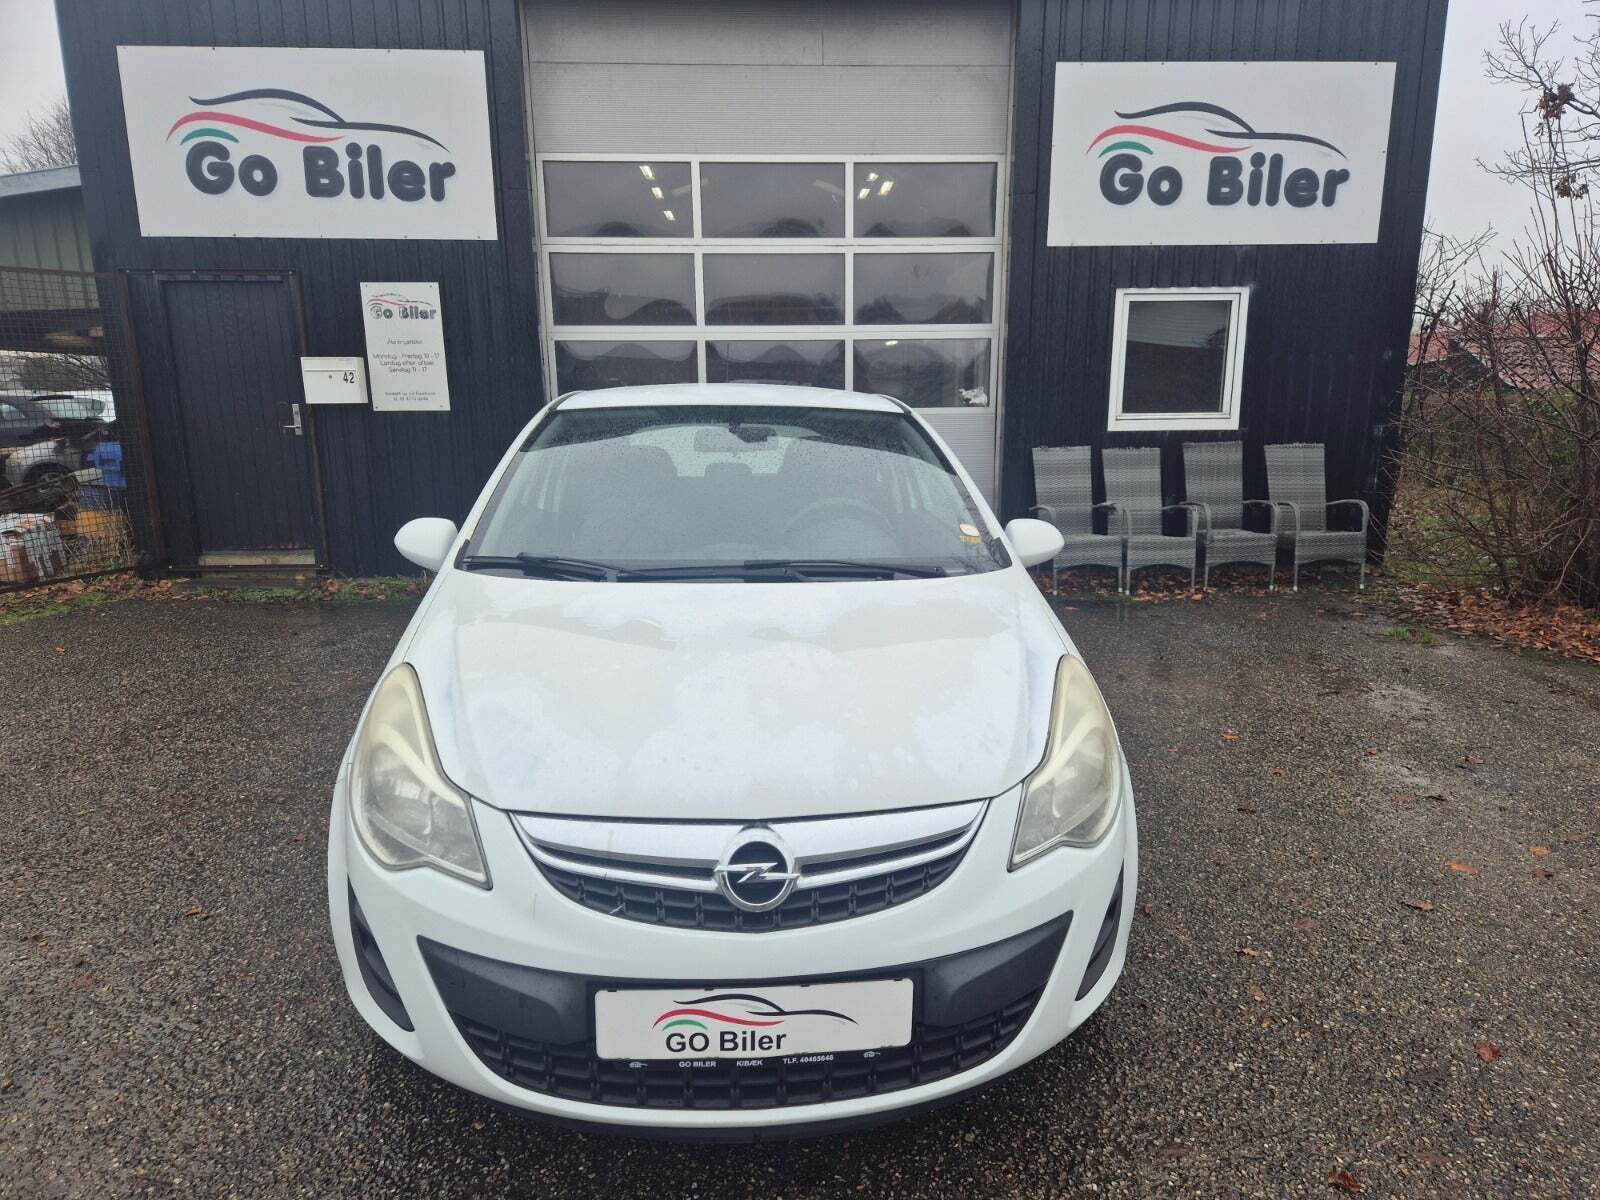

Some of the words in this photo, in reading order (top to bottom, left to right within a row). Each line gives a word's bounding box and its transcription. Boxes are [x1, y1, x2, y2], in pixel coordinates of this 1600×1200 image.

[186, 140, 278, 197] Go
[302, 142, 456, 202] Biler
[1100, 153, 1183, 206] Go
[1206, 151, 1350, 208] Biler
[370, 306, 393, 319] Go
[399, 305, 436, 320] Biler
[343, 371, 355, 384] 42
[665, 1032, 710, 1053] GO
[719, 1030, 787, 1052] Biler
[692, 1060, 717, 1068] BILER
[736, 1059, 763, 1067] KIBÆK
